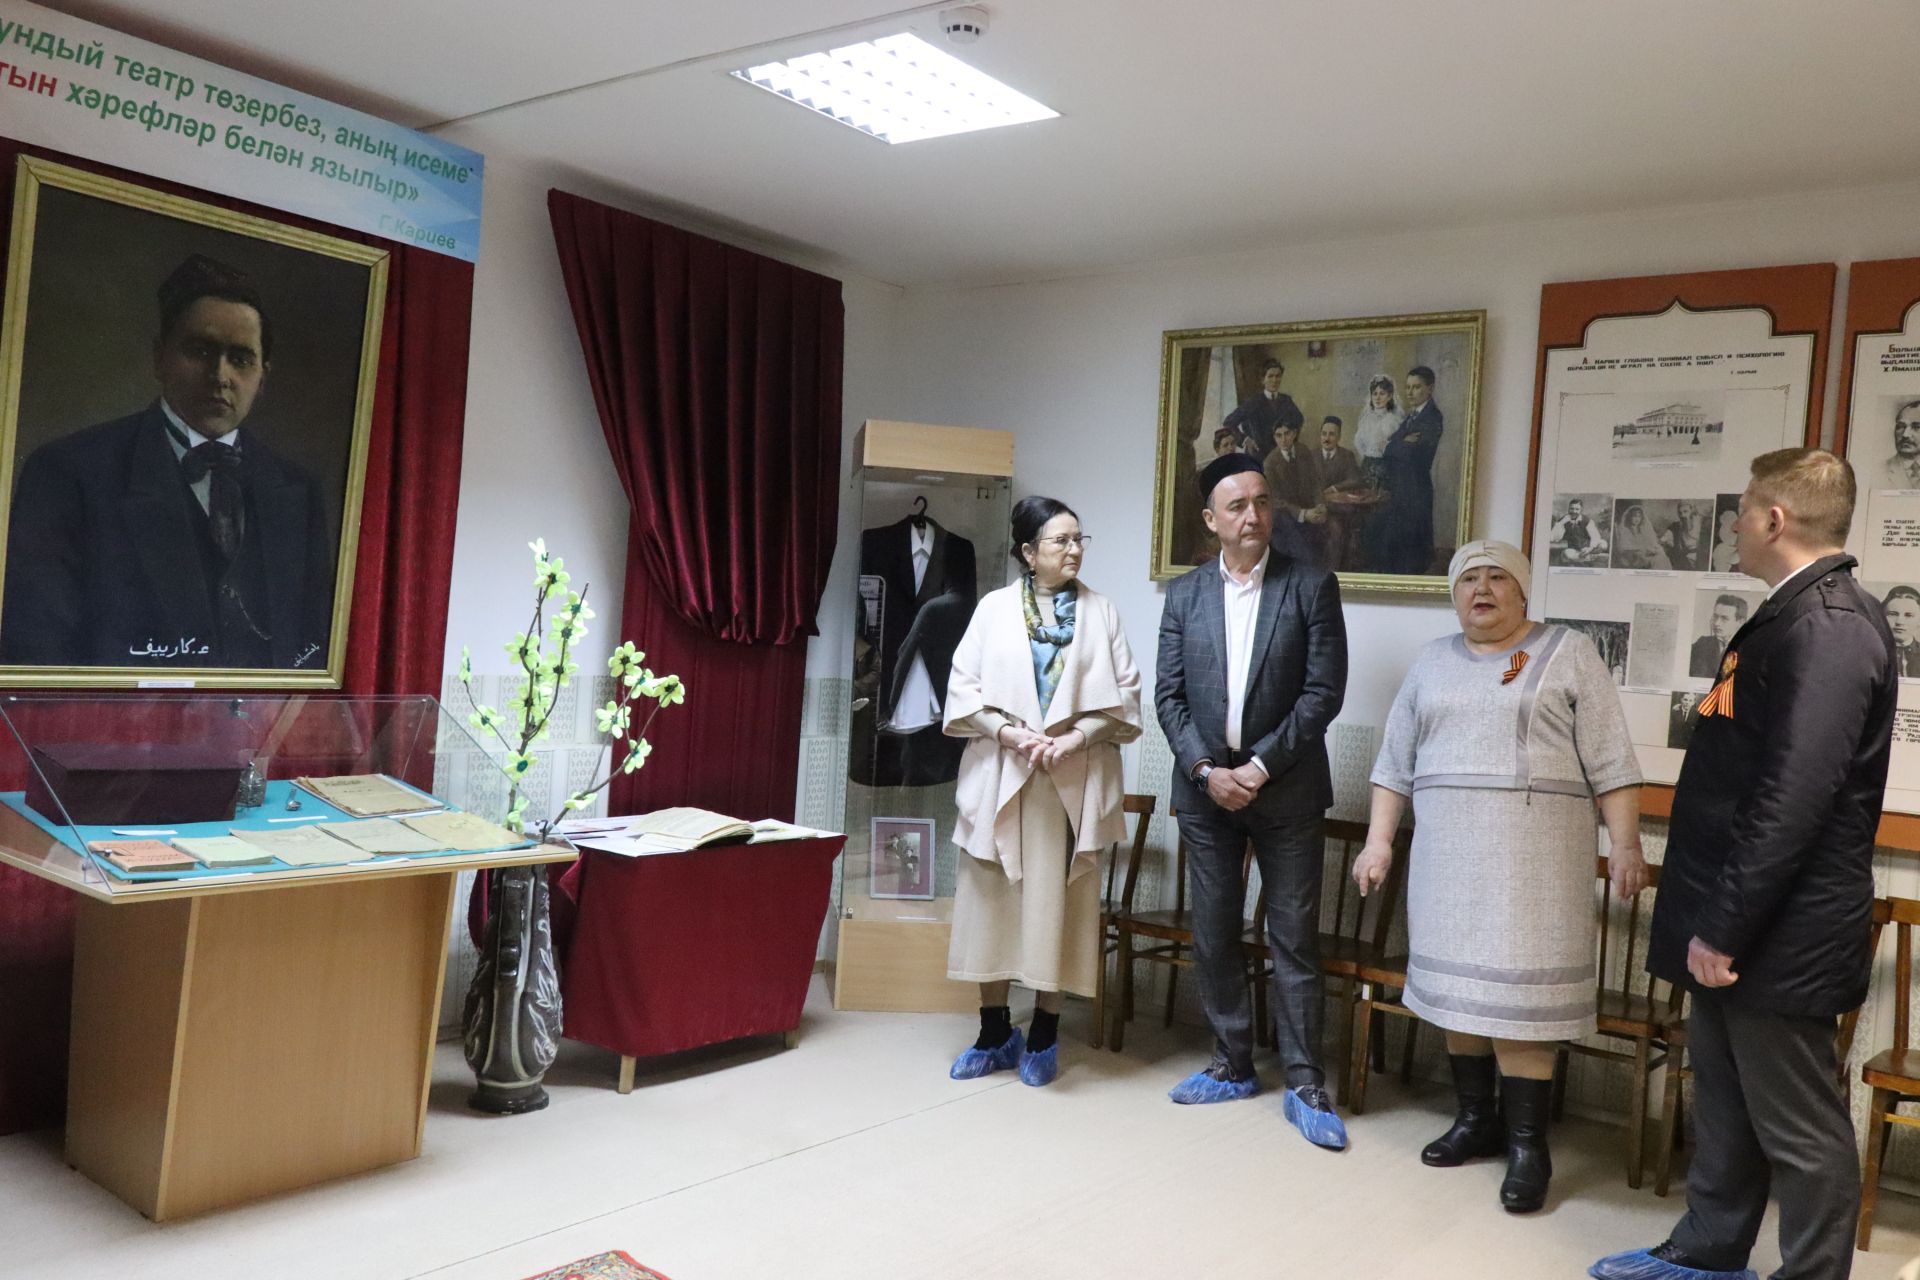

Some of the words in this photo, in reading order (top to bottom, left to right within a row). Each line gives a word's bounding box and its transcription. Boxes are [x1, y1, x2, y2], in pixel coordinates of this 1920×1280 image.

[65, 82, 216, 147] хәрефләр
[224, 124, 304, 168] белән
[309, 155, 419, 205] язылыр»
[114, 54, 195, 101] театр
[203, 83, 326, 143] төзербез,
[335, 126, 398, 166] аның
[403, 148, 470, 183] исеме
